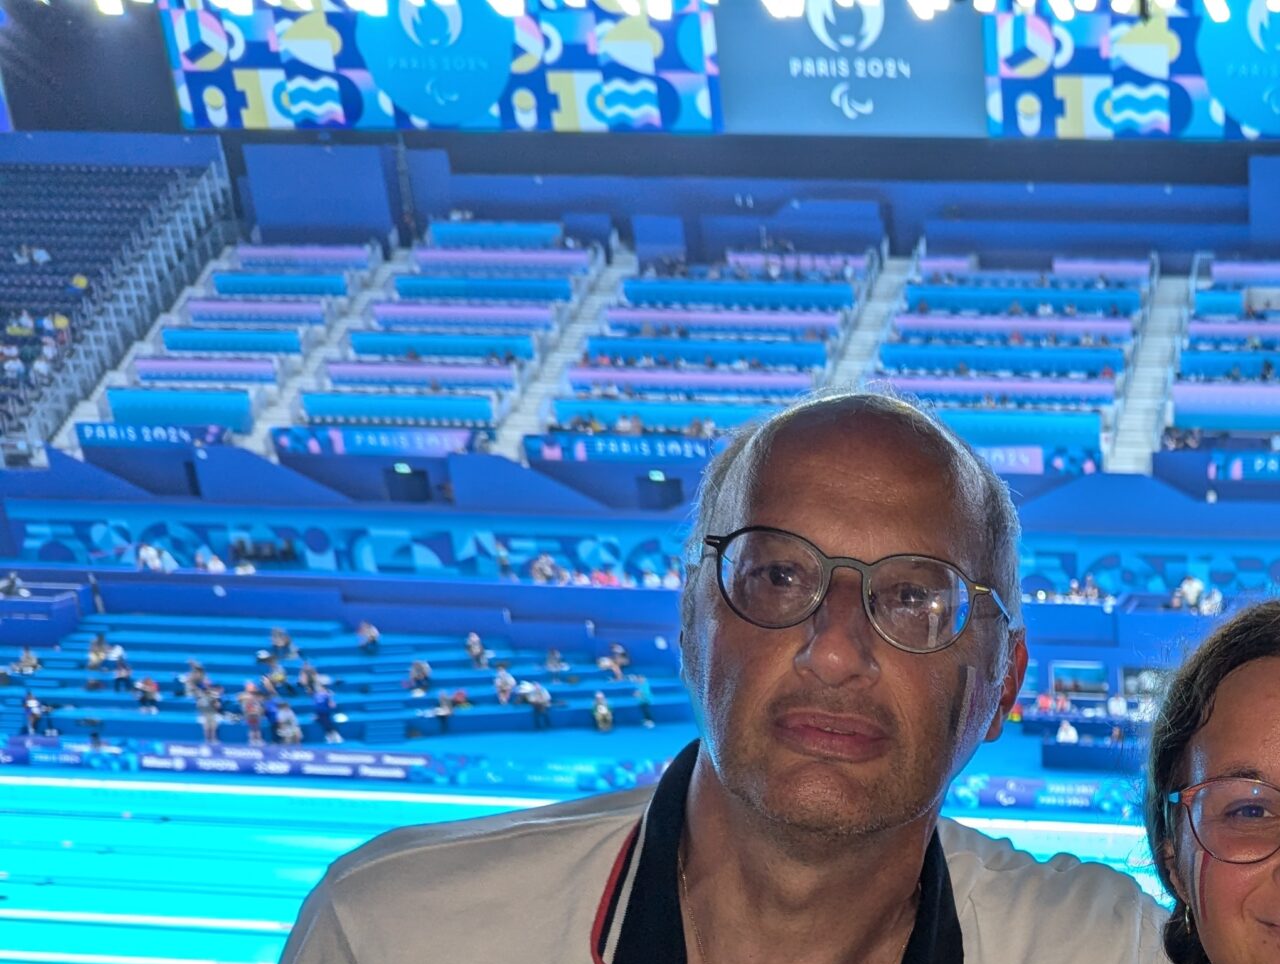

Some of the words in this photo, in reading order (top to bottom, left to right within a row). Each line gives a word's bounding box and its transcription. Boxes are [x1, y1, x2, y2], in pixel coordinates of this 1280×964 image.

[789, 56, 850, 78] PARIS
[853, 56, 911, 79] 2024
[83, 424, 137, 442] PARIS
[140, 424, 192, 444] 2024
[354, 431, 410, 448] PARIS
[595, 439, 650, 457] PARIS
[655, 440, 707, 459] 2024
